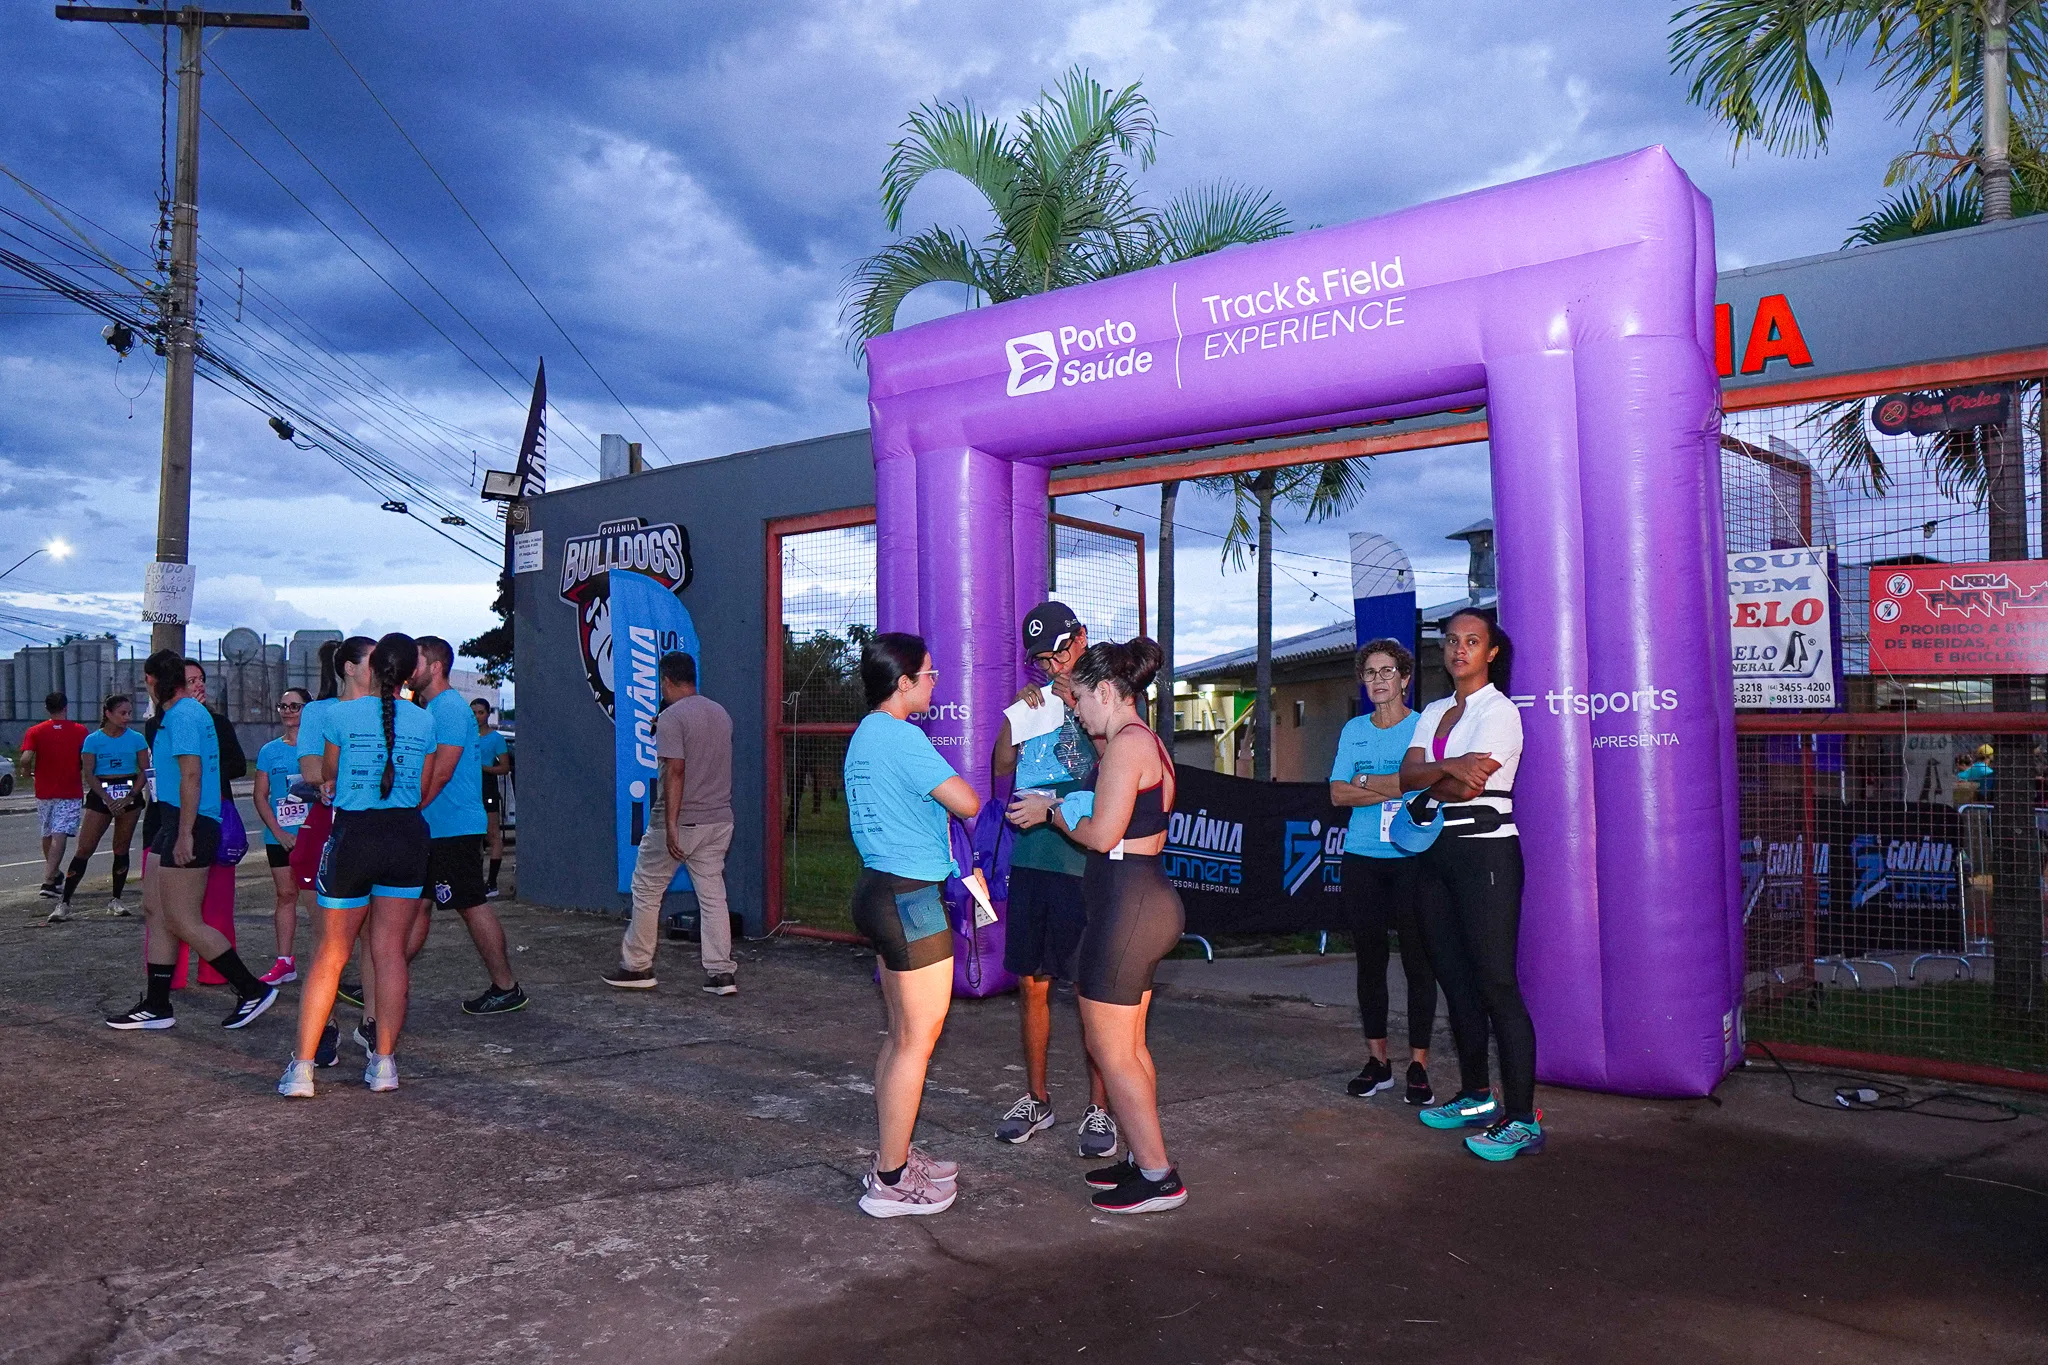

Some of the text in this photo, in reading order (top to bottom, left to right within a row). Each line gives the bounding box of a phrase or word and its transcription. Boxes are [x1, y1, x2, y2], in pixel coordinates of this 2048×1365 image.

[1204, 296, 1407, 361] EXPERIENCE
[1059, 318, 1137, 356] Porto
[1061, 347, 1153, 387] Saúde
[1909, 401, 1944, 419] Sem
[601, 523, 636, 535] GOIÂNIA
[562, 528, 681, 593] BULLDOGS
[1728, 550, 1824, 574] QUI
[1952, 574, 2006, 589] ARENA
[1731, 598, 1825, 629] ELO
[1900, 624, 1983, 635] PROIBIDO
[1988, 623, 2000, 633] A
[1885, 639, 1907, 649] DE
[1912, 637, 1990, 650] BEBIDAS,
[1935, 653, 1944, 663] E
[1734, 682, 1763, 693] -3218
[1779, 682, 1831, 693] 3455-4200
[627, 626, 659, 769] GOIÂNIA
[1545, 685, 1679, 721] tfsports
[1776, 694, 1831, 704] 98133-0054
[1593, 733, 1680, 749] APRESENTA
[279, 805, 306, 817] 1035
[1172, 879, 1241, 894] SSORIA ESPORTIVA
